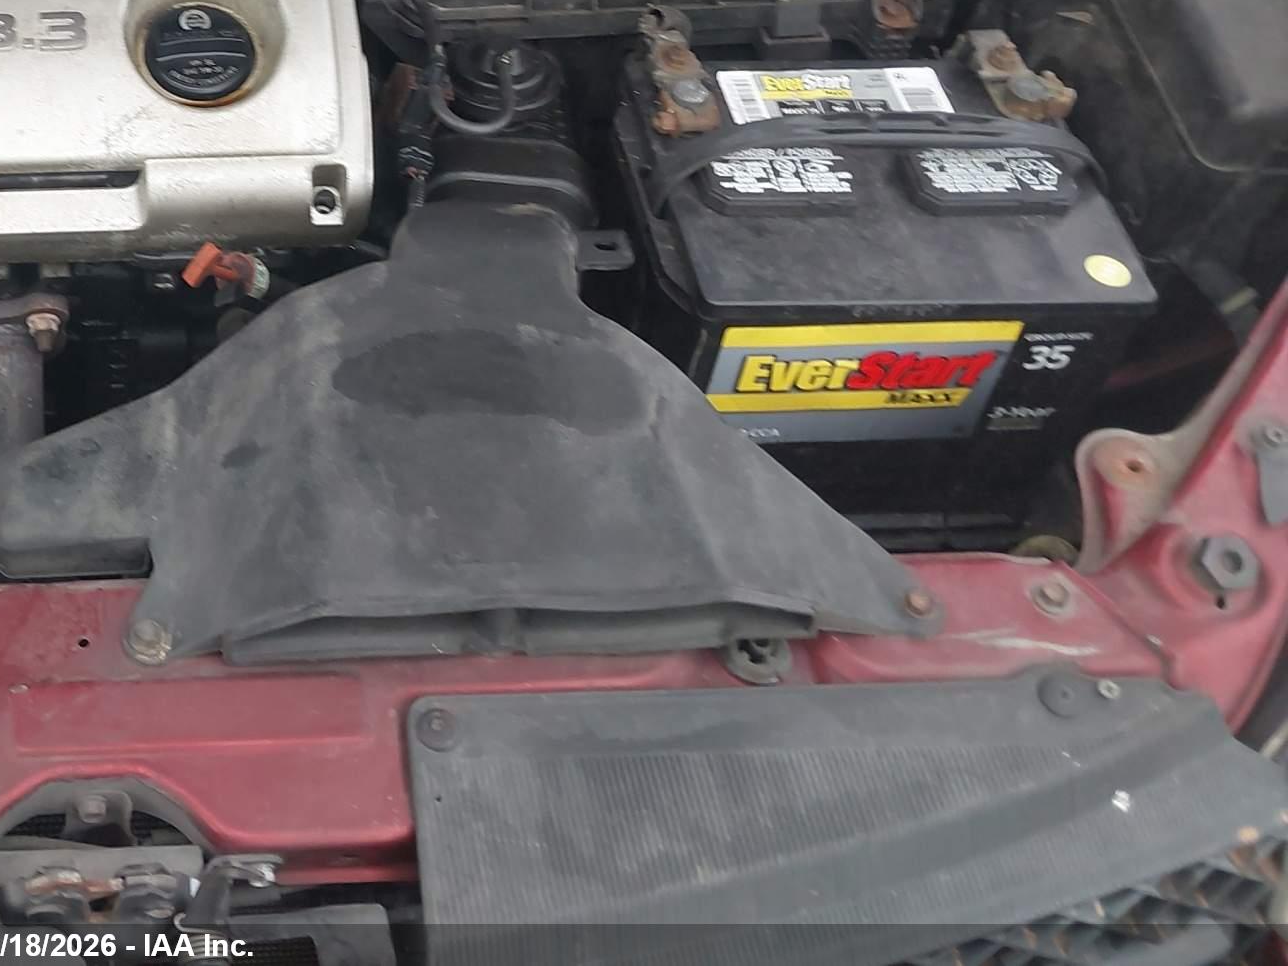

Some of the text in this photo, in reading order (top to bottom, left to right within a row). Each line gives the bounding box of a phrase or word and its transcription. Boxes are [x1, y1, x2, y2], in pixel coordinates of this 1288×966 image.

[761, 74, 851, 91] EverStart
[1022, 344, 1076, 369] 35
[735, 350, 998, 393] EverStart
[886, 391, 954, 405] MAXX
